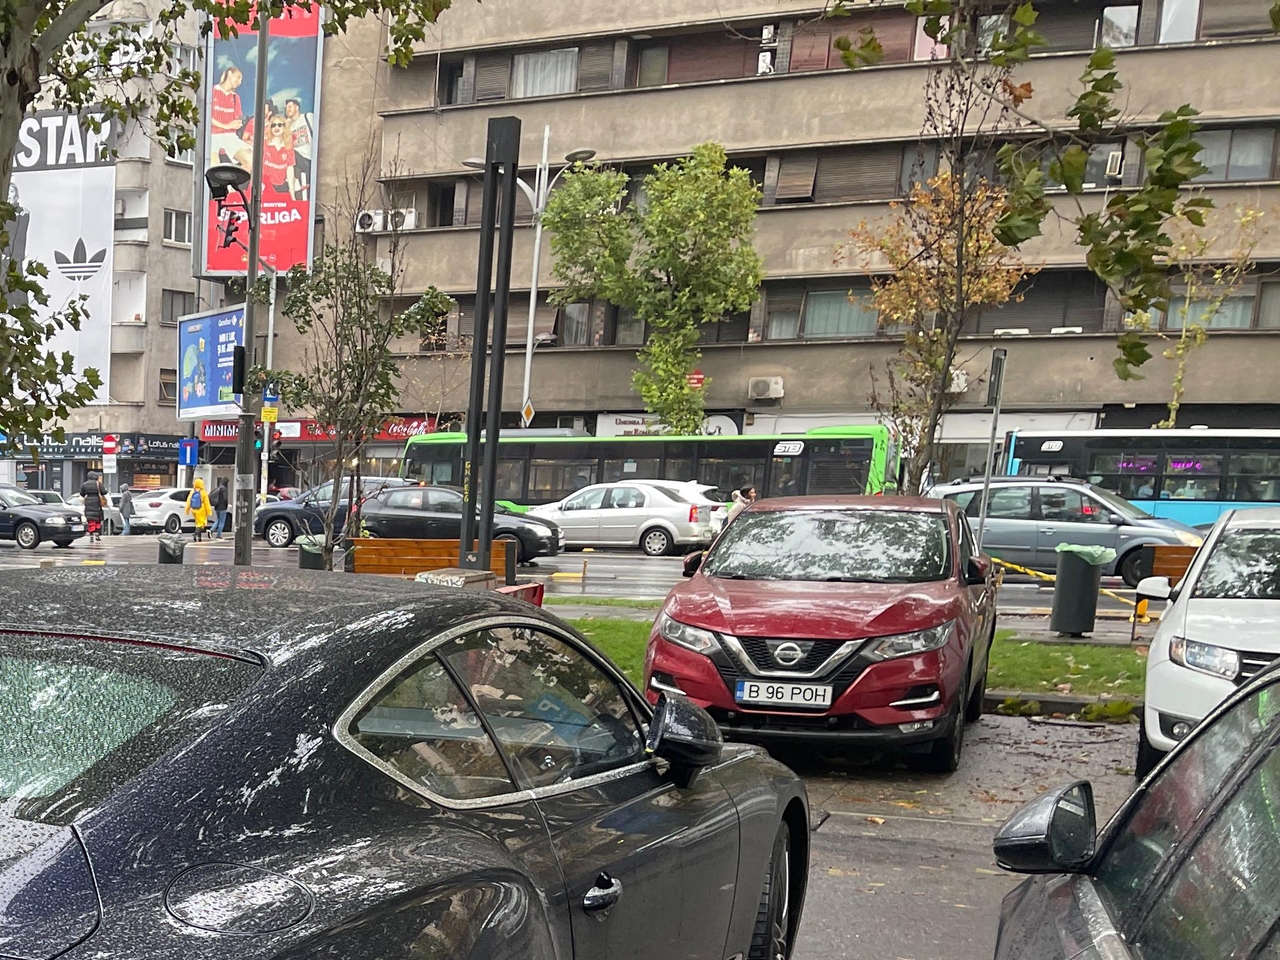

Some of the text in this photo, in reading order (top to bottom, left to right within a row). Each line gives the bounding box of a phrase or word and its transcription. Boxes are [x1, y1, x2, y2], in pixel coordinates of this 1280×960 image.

[12, 113, 111, 168] STAR
[217, 207, 302, 225] SPRLIGA
[748, 684, 827, 702] B 96 POH
